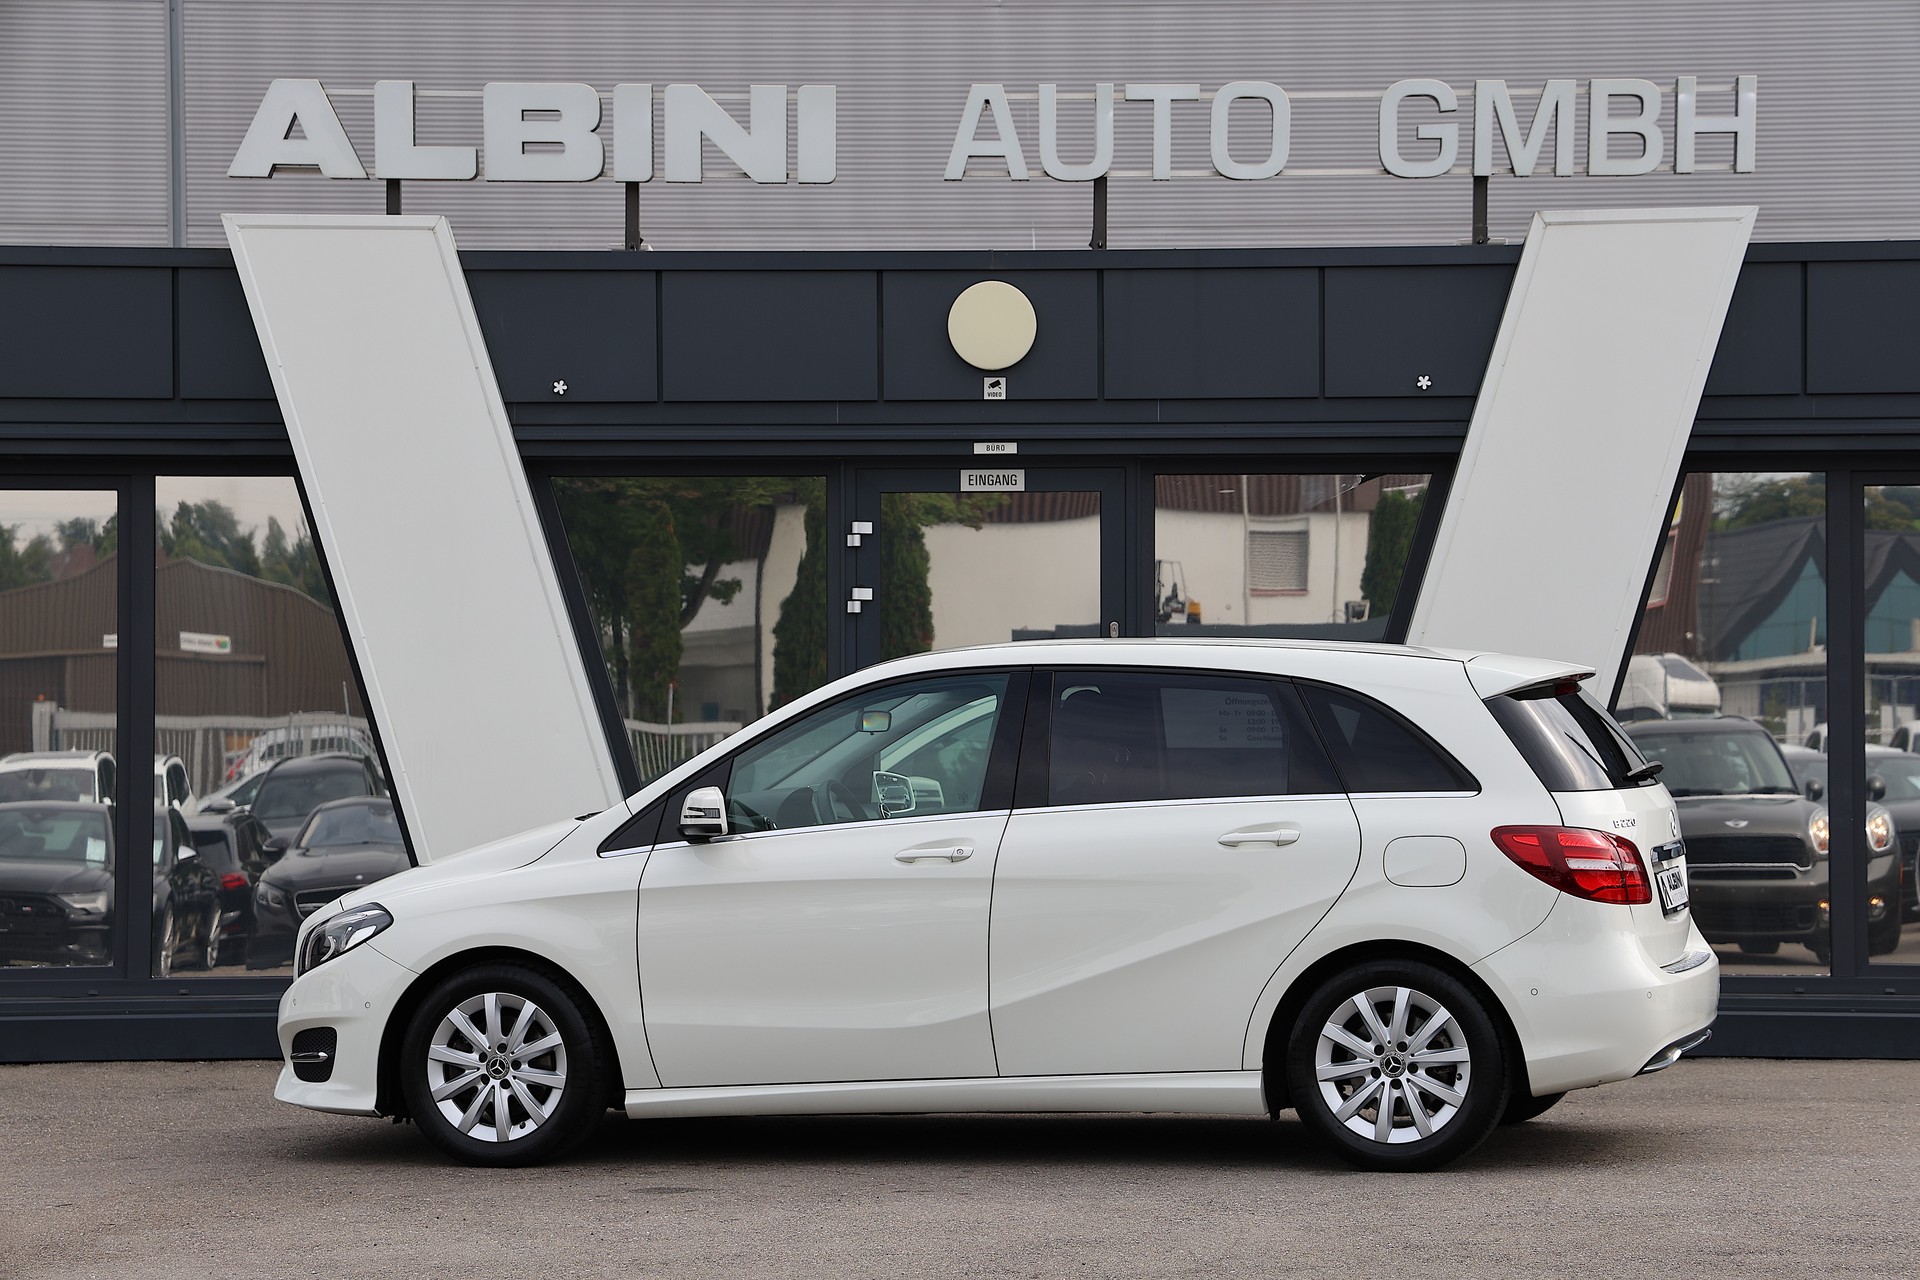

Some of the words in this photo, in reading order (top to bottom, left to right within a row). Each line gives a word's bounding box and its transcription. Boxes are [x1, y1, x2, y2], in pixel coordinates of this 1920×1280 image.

[227, 78, 836, 185] ALBINI
[943, 81, 1291, 182] AUTO
[1378, 75, 1757, 178] GMBH
[985, 443, 1005, 452] BÜRO
[968, 474, 1018, 486] EINGANG
